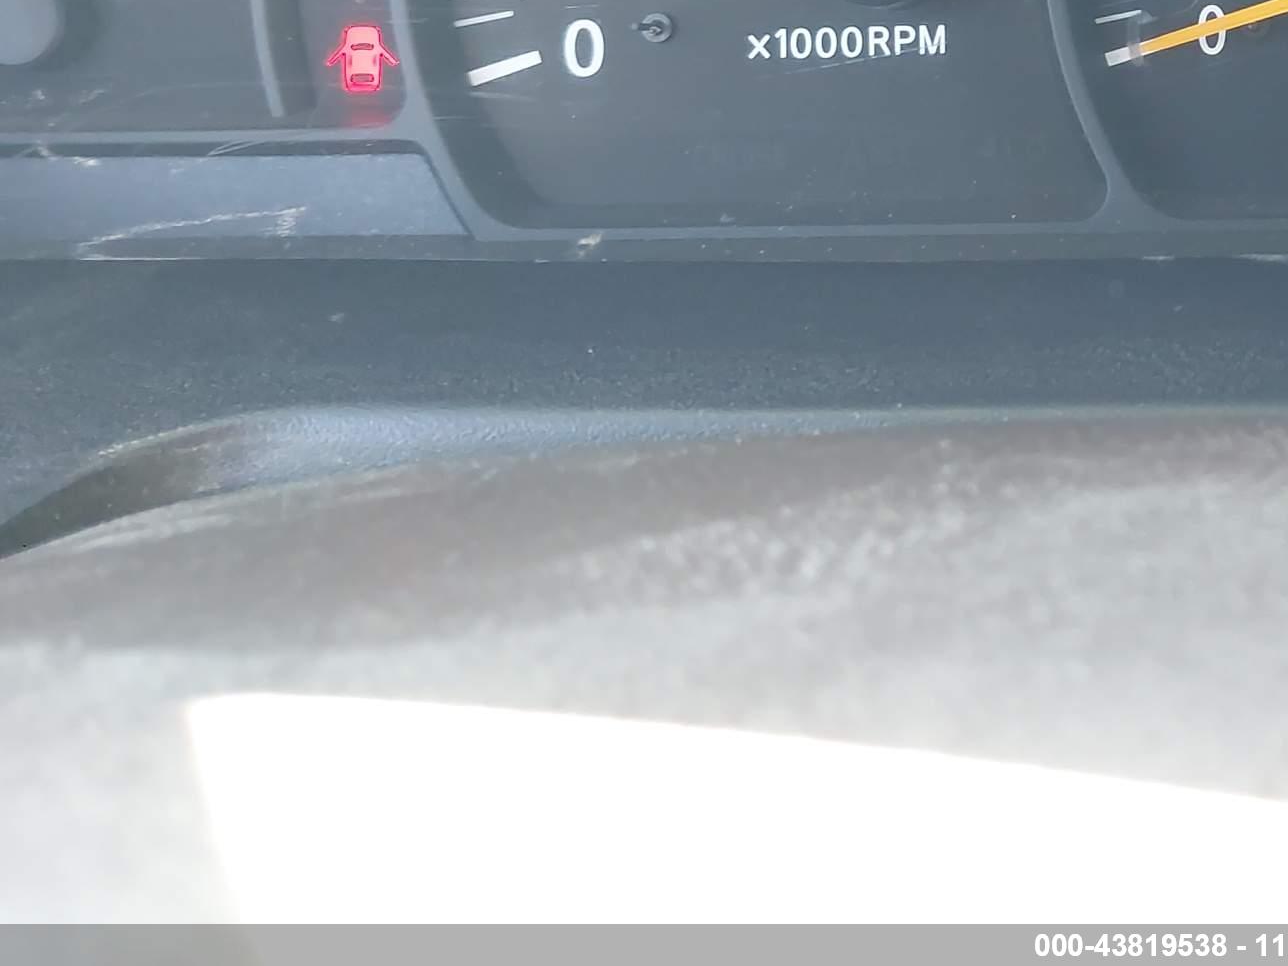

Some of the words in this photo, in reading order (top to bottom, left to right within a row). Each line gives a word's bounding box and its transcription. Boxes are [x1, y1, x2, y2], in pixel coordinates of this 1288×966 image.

[564, 20, 604, 77] 0
[748, 25, 945, 59] x1000RPM
[1198, 5, 1226, 55] 0
